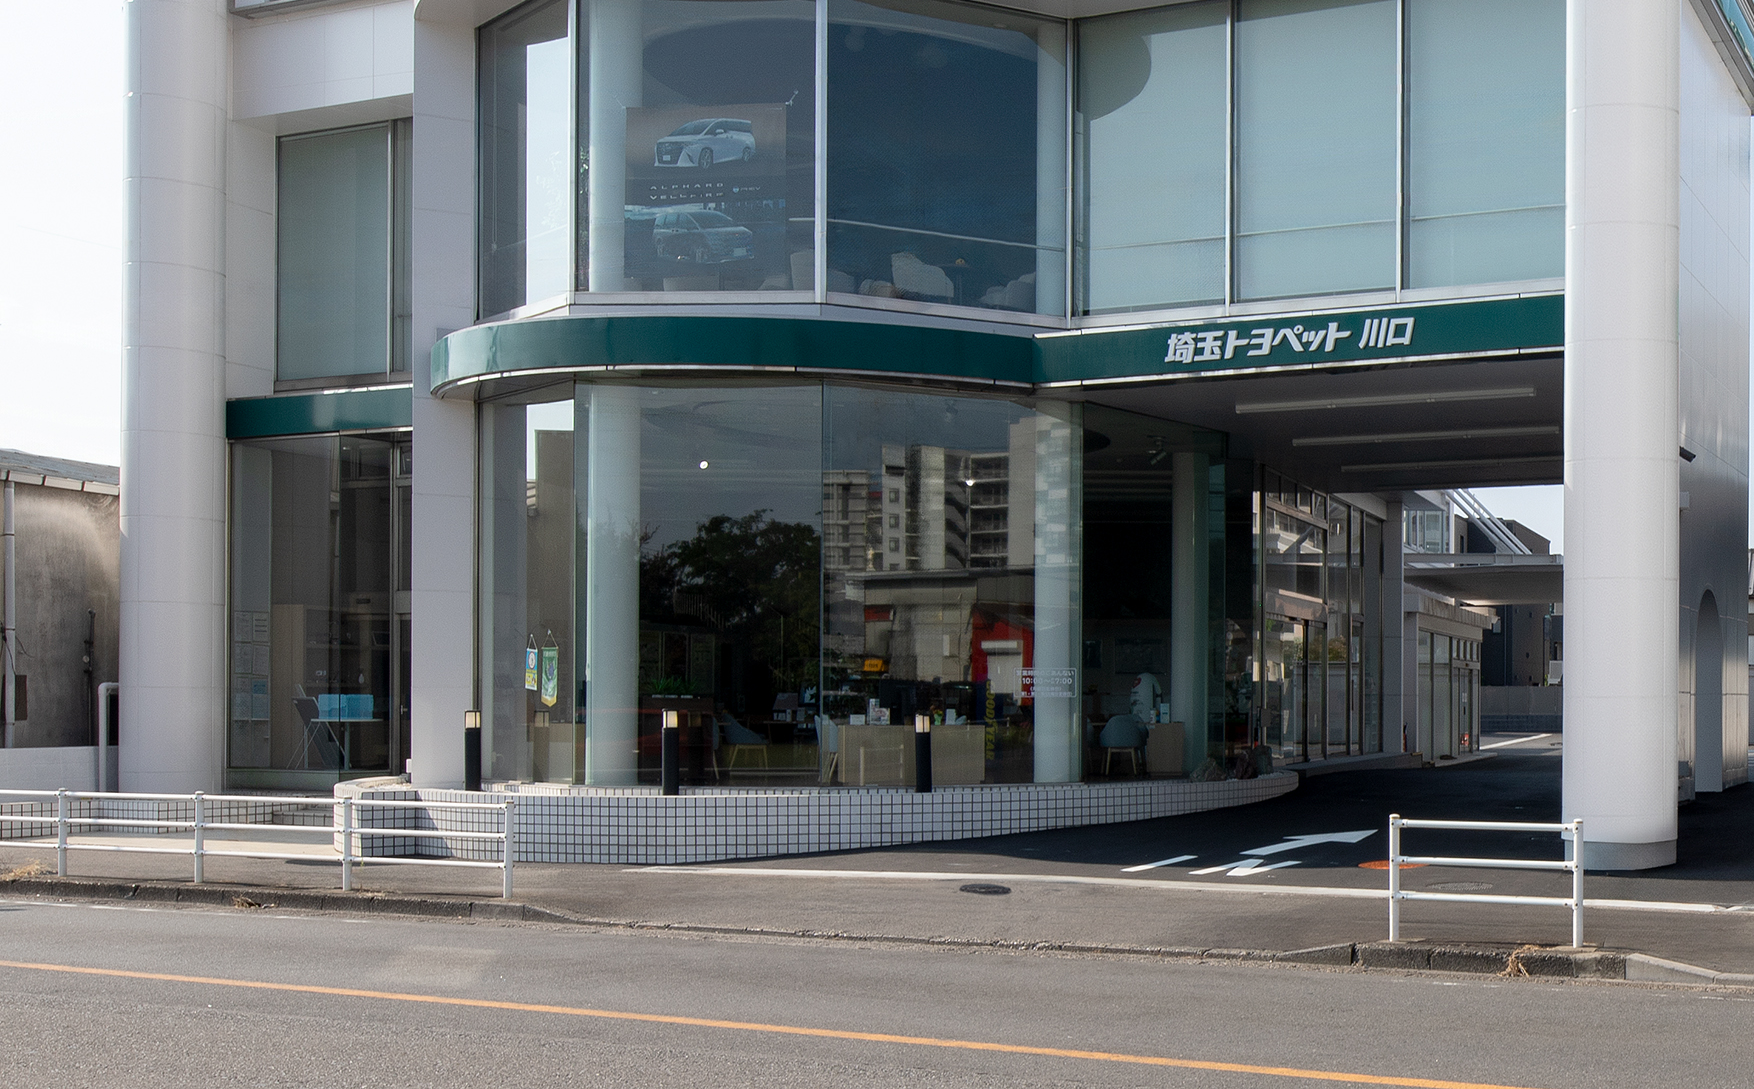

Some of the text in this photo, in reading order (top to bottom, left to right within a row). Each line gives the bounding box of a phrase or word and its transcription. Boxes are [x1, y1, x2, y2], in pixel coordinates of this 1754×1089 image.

[650, 182, 724, 190] ALPHARD
[1164, 317, 1416, 363] 埼玉トヨペット 川口
[1120, 855, 1302, 876] IN
